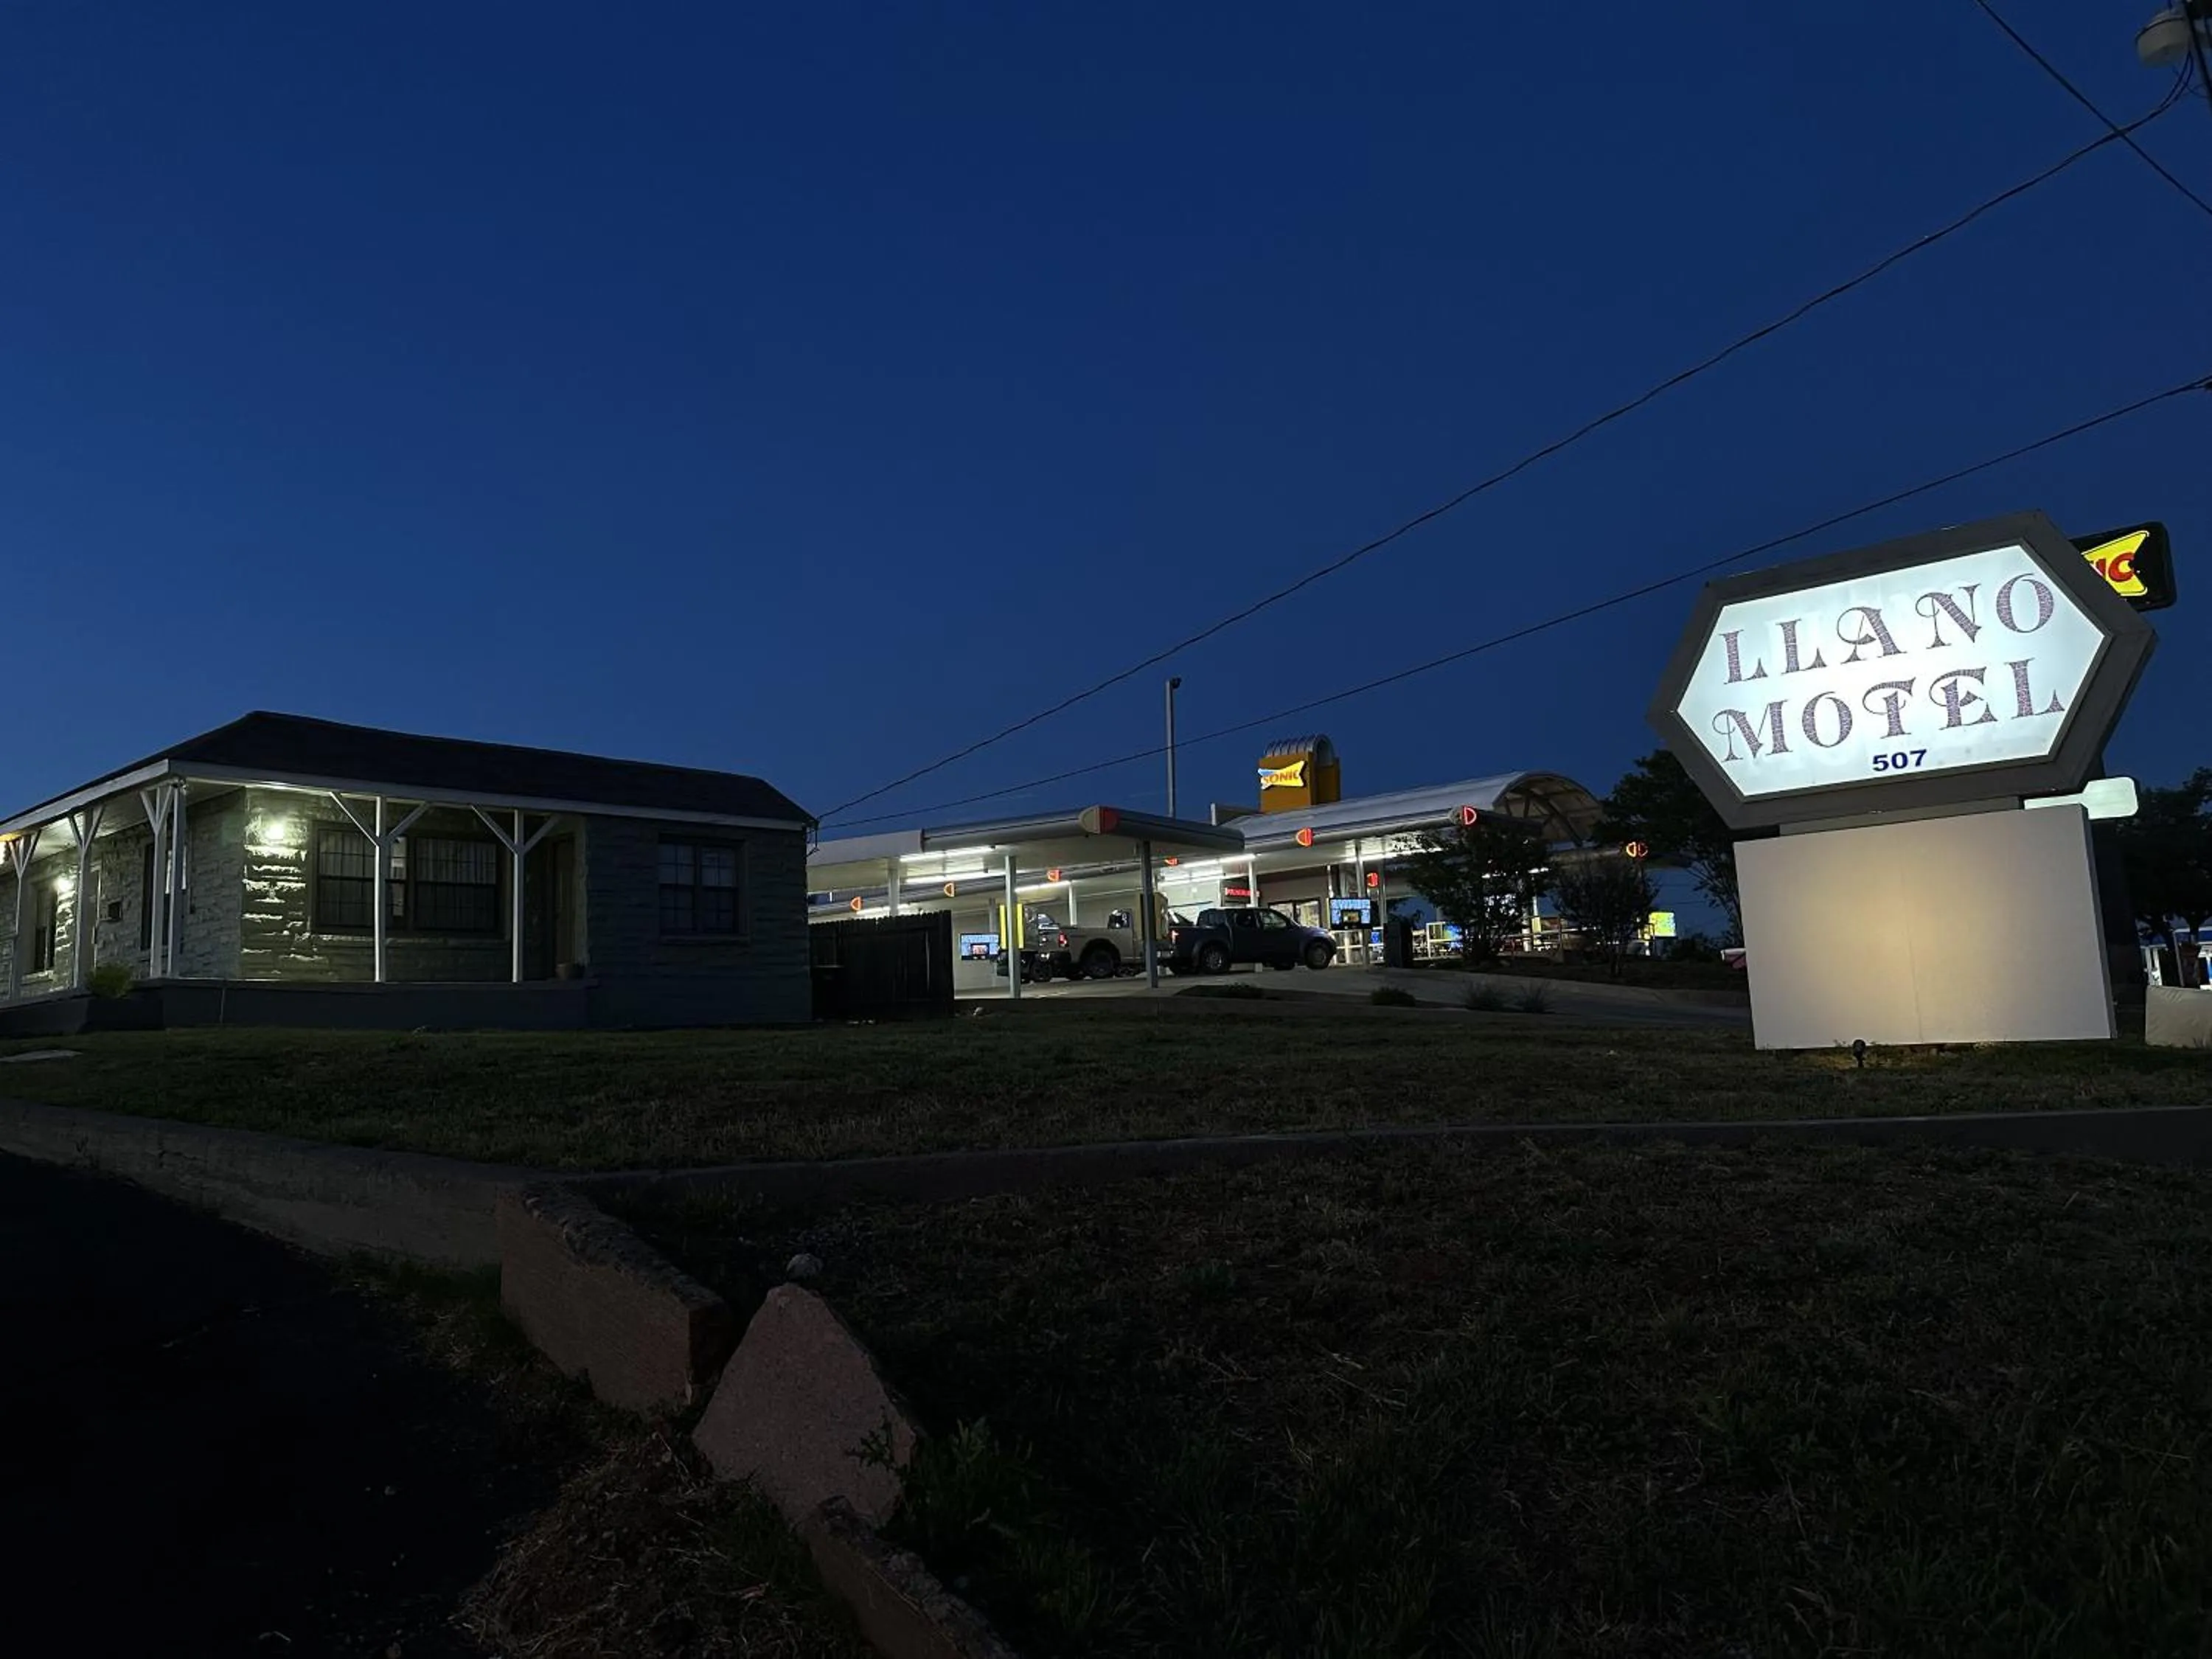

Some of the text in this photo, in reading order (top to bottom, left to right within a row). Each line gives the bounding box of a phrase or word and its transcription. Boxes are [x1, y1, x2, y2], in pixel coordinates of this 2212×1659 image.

[1719, 573, 2055, 685] LLANO
[1712, 658, 2065, 763] MOTEL
[1262, 769, 1300, 783] SONIC
[1873, 749, 1927, 771] 507
